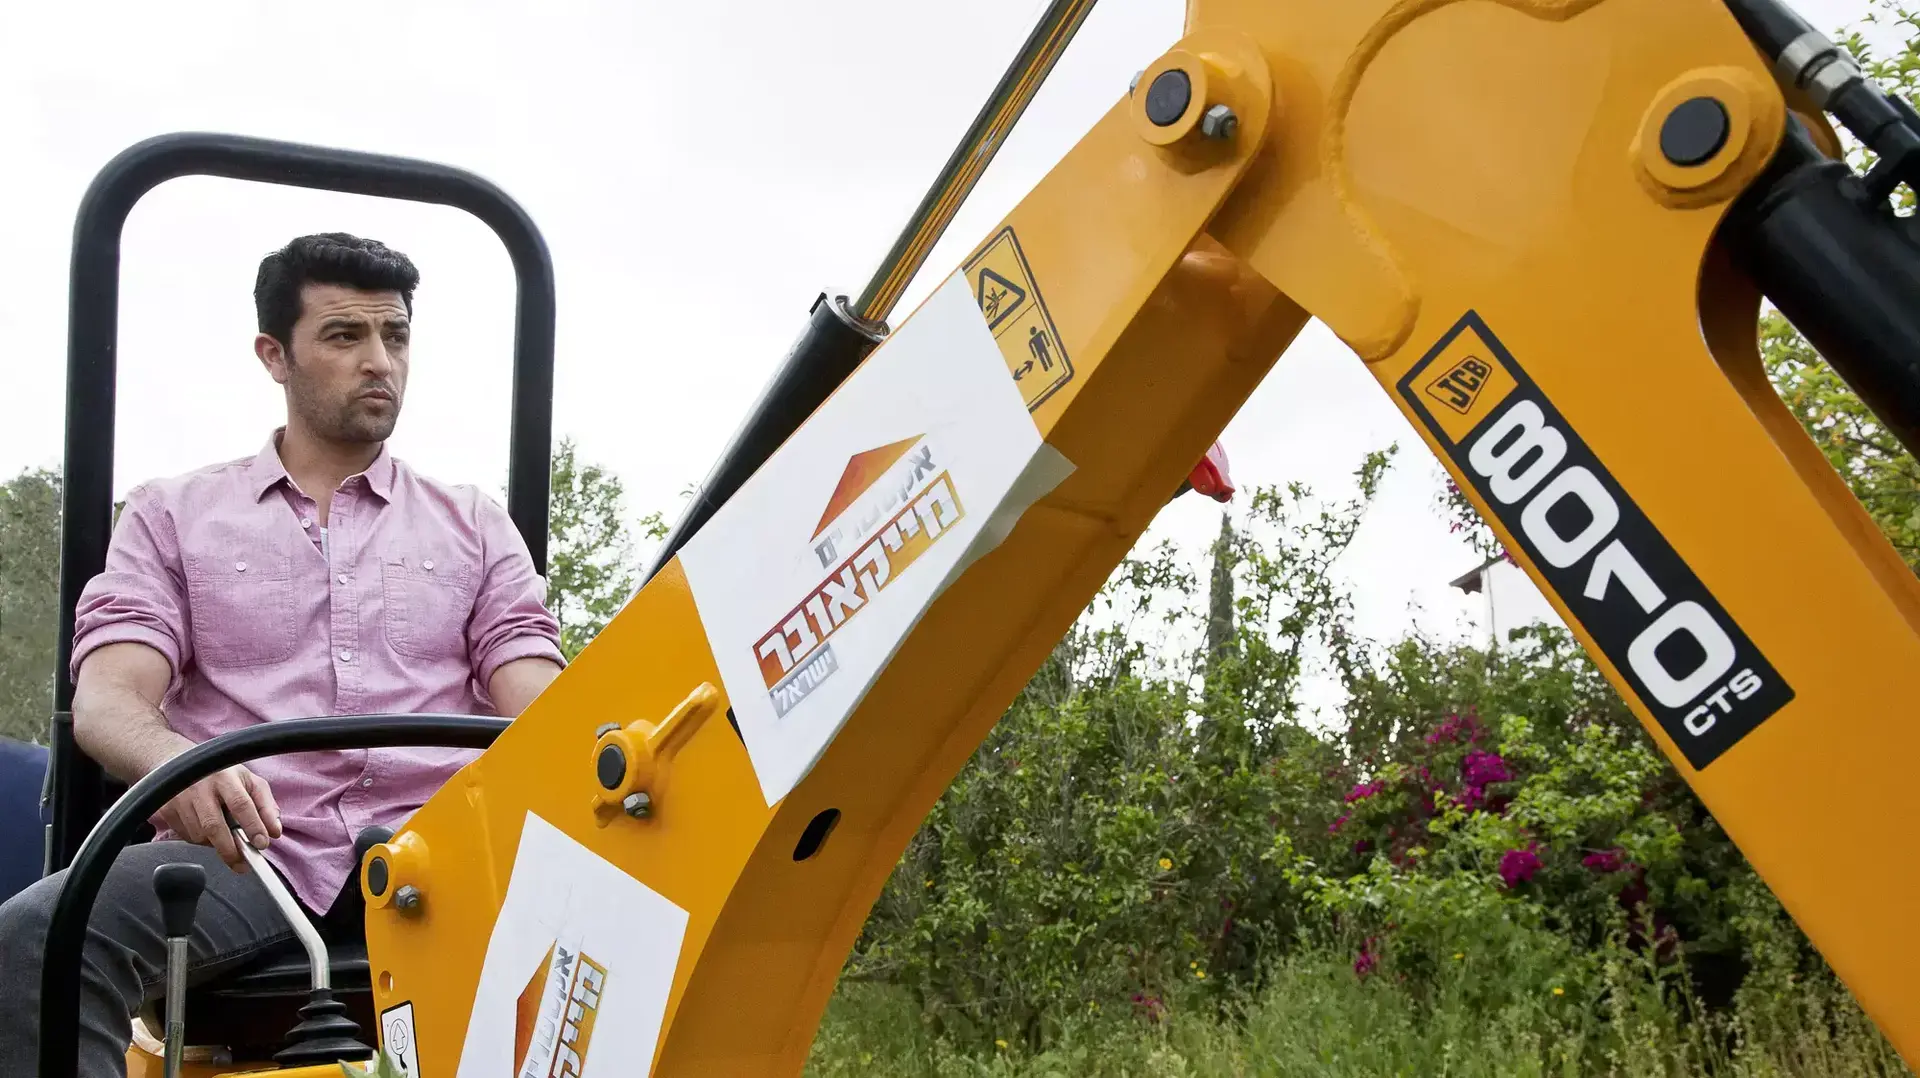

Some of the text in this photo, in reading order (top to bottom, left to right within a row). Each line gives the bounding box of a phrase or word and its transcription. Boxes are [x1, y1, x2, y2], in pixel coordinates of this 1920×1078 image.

[1436, 360, 1489, 408] JCB
[758, 478, 961, 673] מייקאובר
[1468, 400, 1736, 708] 8010
[773, 652, 831, 712] ישראל
[1683, 668, 1763, 737] CTS
[519, 946, 574, 1078] אקסטרי
